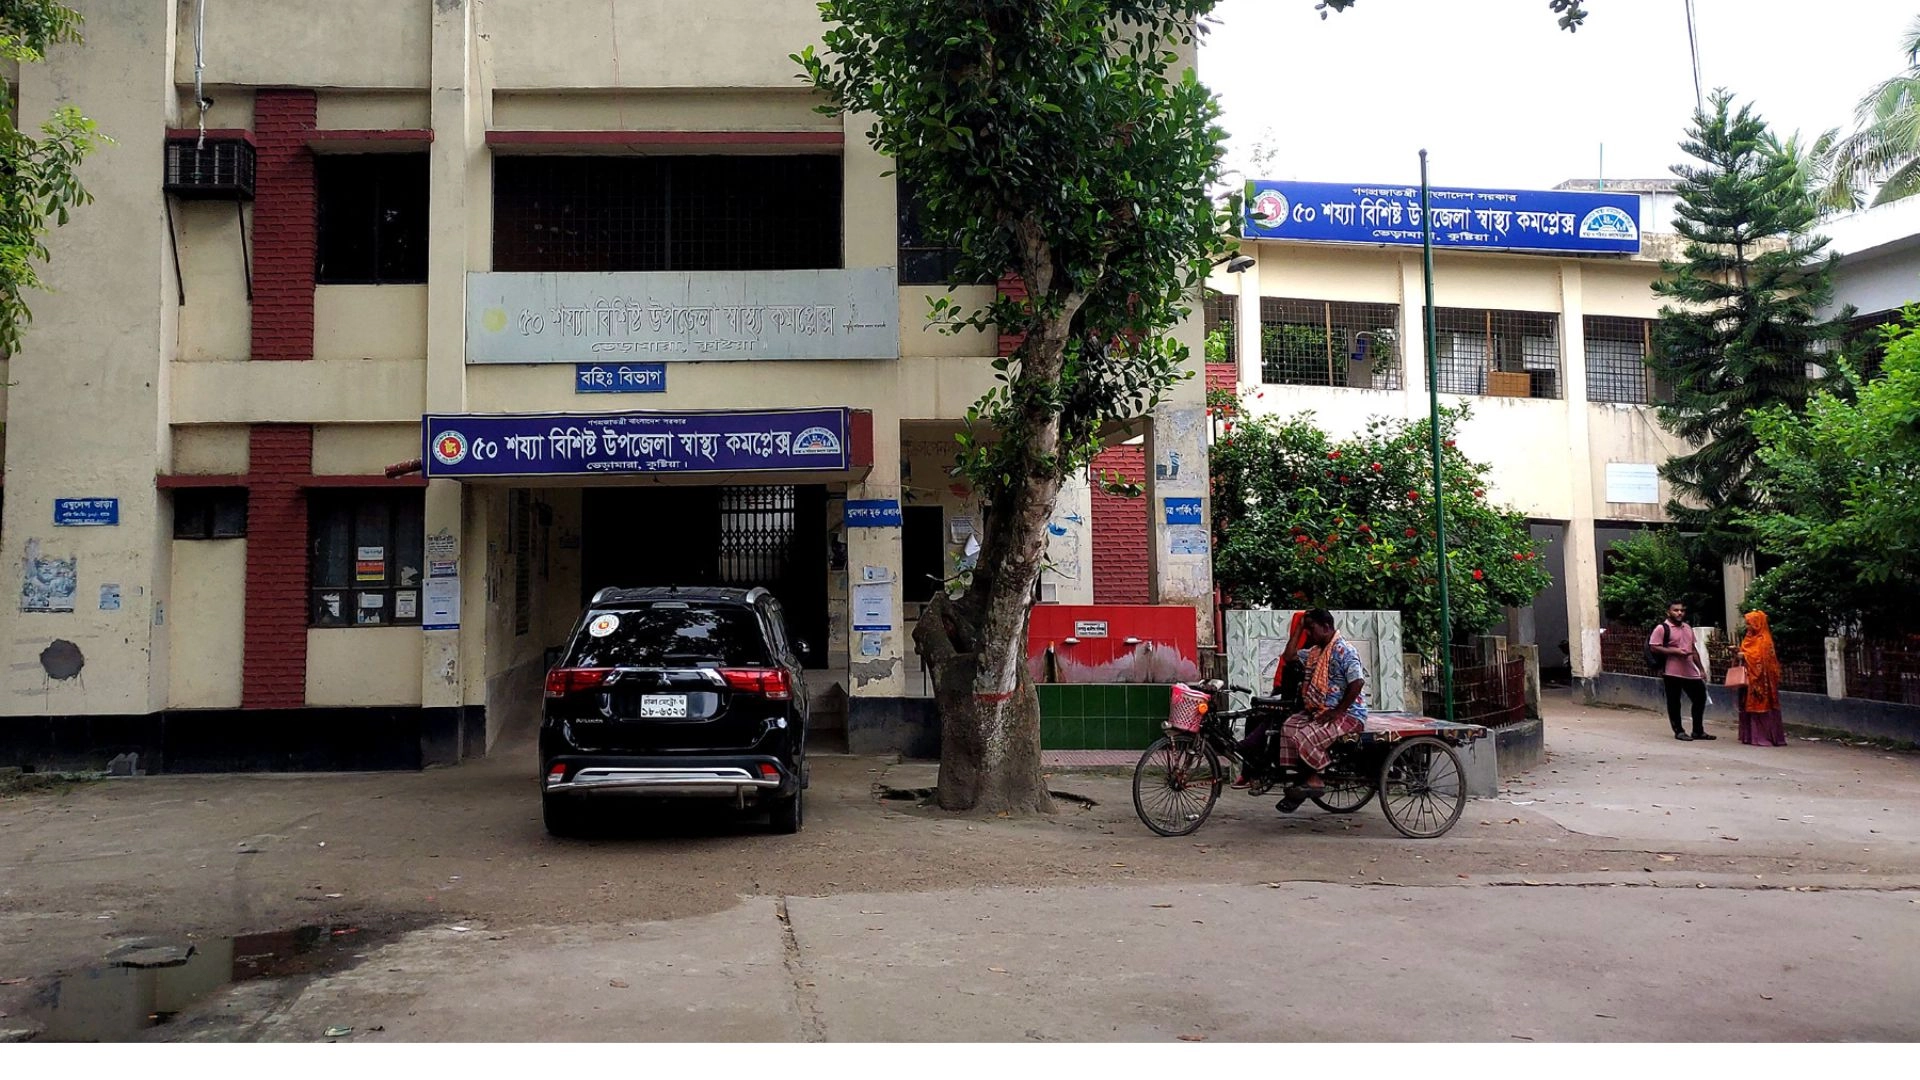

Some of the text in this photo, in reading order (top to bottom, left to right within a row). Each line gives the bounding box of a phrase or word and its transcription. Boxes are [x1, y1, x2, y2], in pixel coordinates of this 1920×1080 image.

[1352, 188, 1518, 202] গণপ্রজাতন্ত্রী াংলাদেশ সরকার
[1292, 202, 1316, 223] ৫০
[1321, 201, 1357, 226] শয্যা
[1360, 197, 1403, 227] বিশিষ্ট
[1407, 200, 1471, 231] উজেলা
[1474, 208, 1513, 236] স্বাস্থ্য
[1515, 210, 1576, 236] কমপ্লেক্স
[1372, 229, 1441, 241] ভেড়ামাা,
[517, 296, 836, 341] ৫০ শয্যা বিশিষ্ট উপজেলা স্বাস্থ্য কমপ্লেক্স
[579, 366, 662, 388] বহিঃ বিভাগ
[472, 436, 498, 460] ৫০
[504, 434, 544, 460] শয্যা
[549, 427, 598, 459] বিশিষ্ট
[602, 427, 674, 458] উপজেলা
[677, 430, 721, 463] স্বাস্থ্য
[724, 429, 792, 458] কমপ্লেক্স
